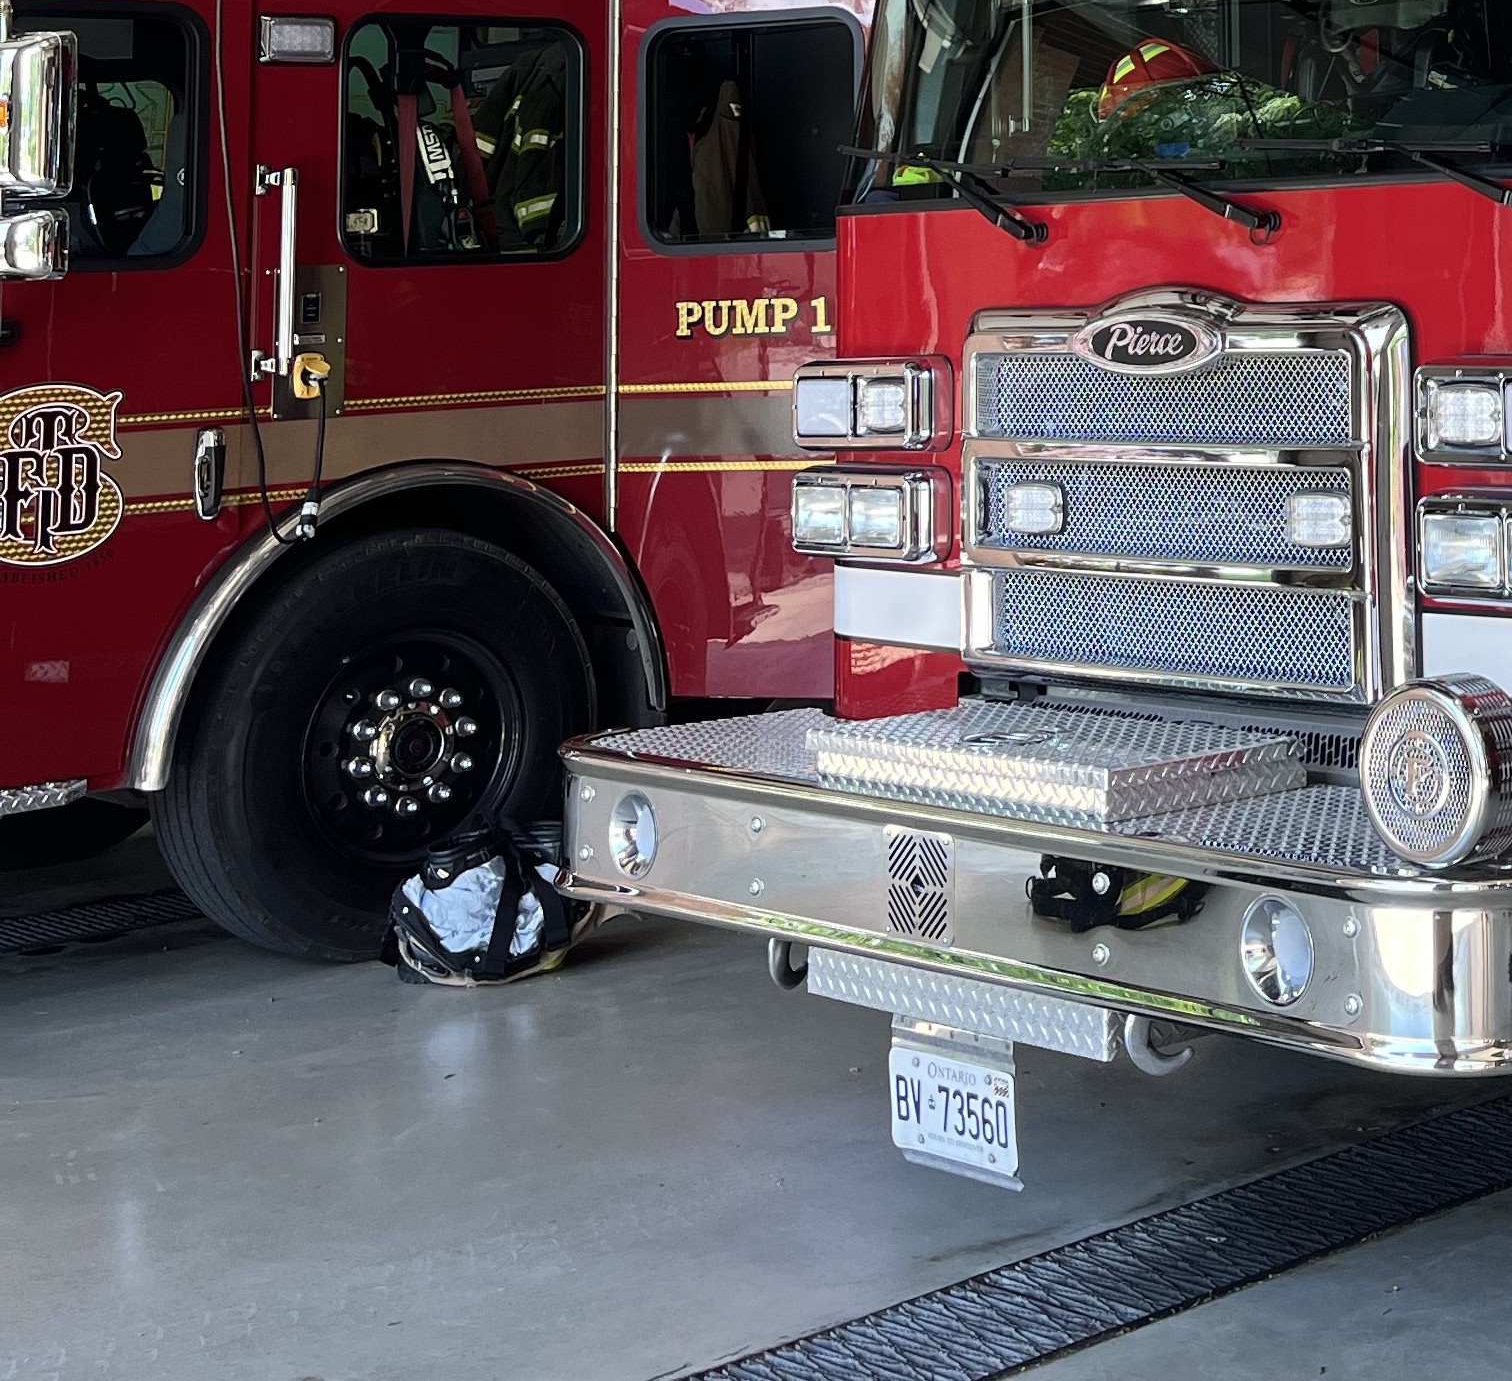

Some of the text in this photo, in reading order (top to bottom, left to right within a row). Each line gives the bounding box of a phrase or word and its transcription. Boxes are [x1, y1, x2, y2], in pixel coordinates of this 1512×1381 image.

[675, 296, 834, 340] PUMP 1
[1104, 322, 1184, 360] Pierce
[927, 1061, 977, 1087] ONTARIO
[895, 1073, 1009, 1149] BV 73560
